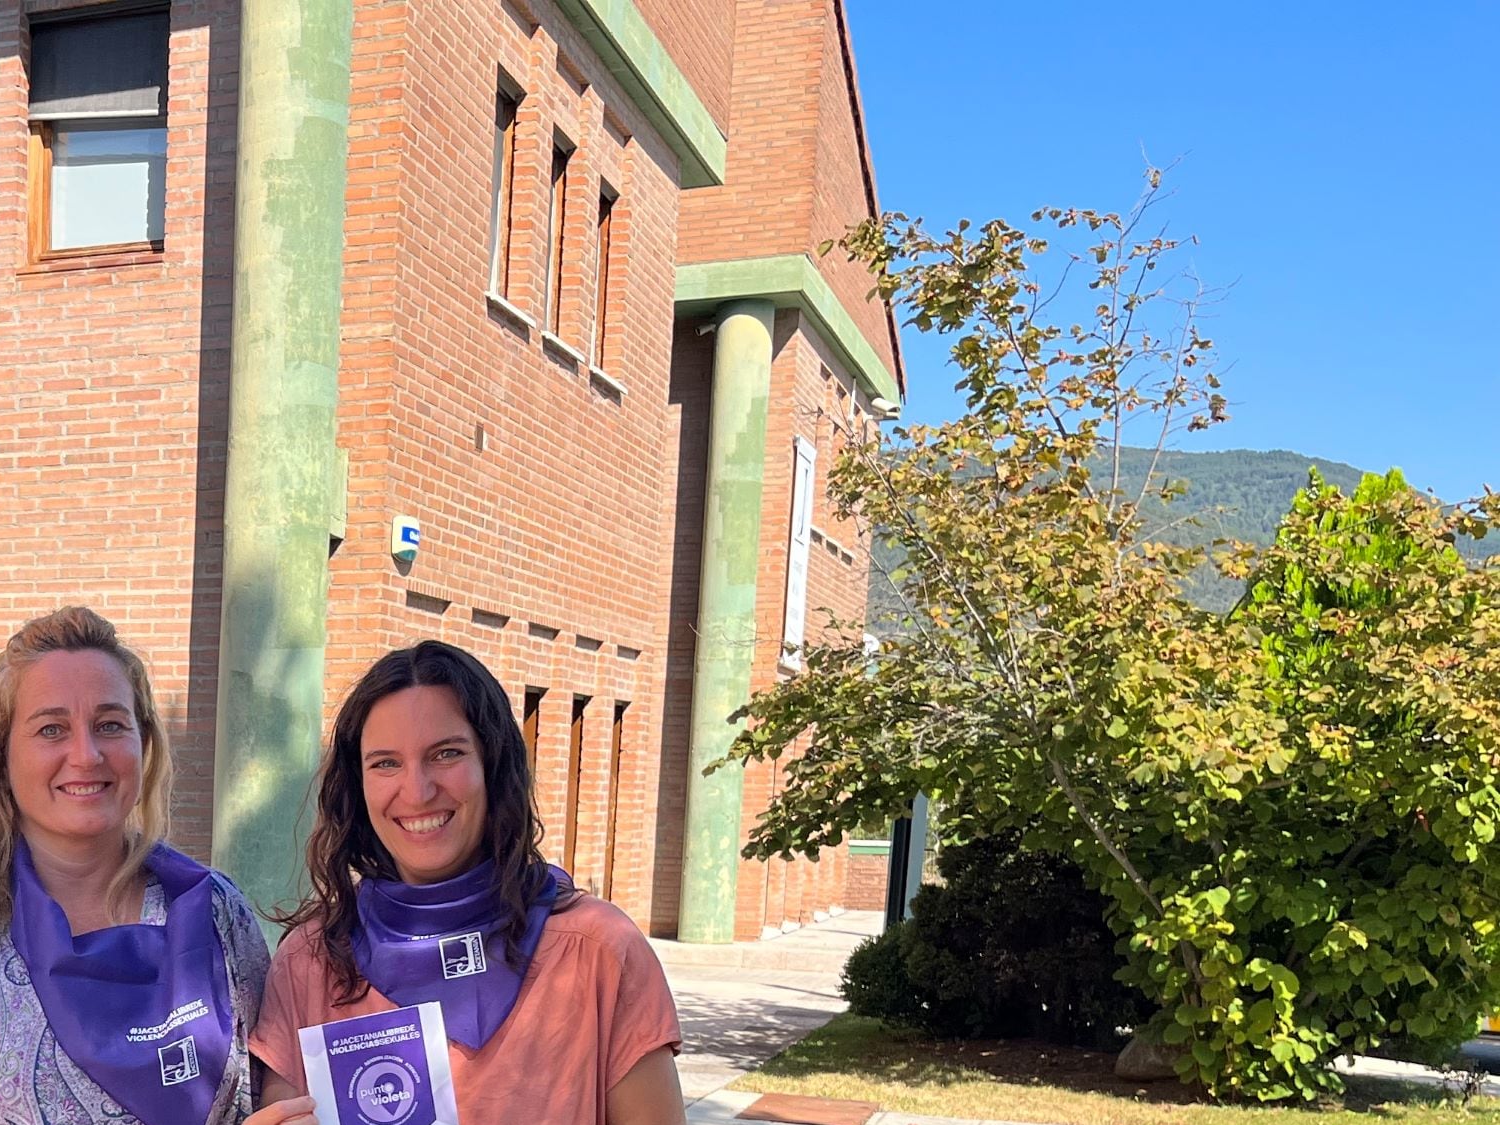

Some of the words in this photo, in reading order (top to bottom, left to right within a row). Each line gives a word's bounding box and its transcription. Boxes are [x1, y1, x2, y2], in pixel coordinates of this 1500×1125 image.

[329, 1031, 420, 1055] VIOLENCIASSEXUALES
[360, 1082, 395, 1099] punto
[371, 1090, 411, 1105] violeta
